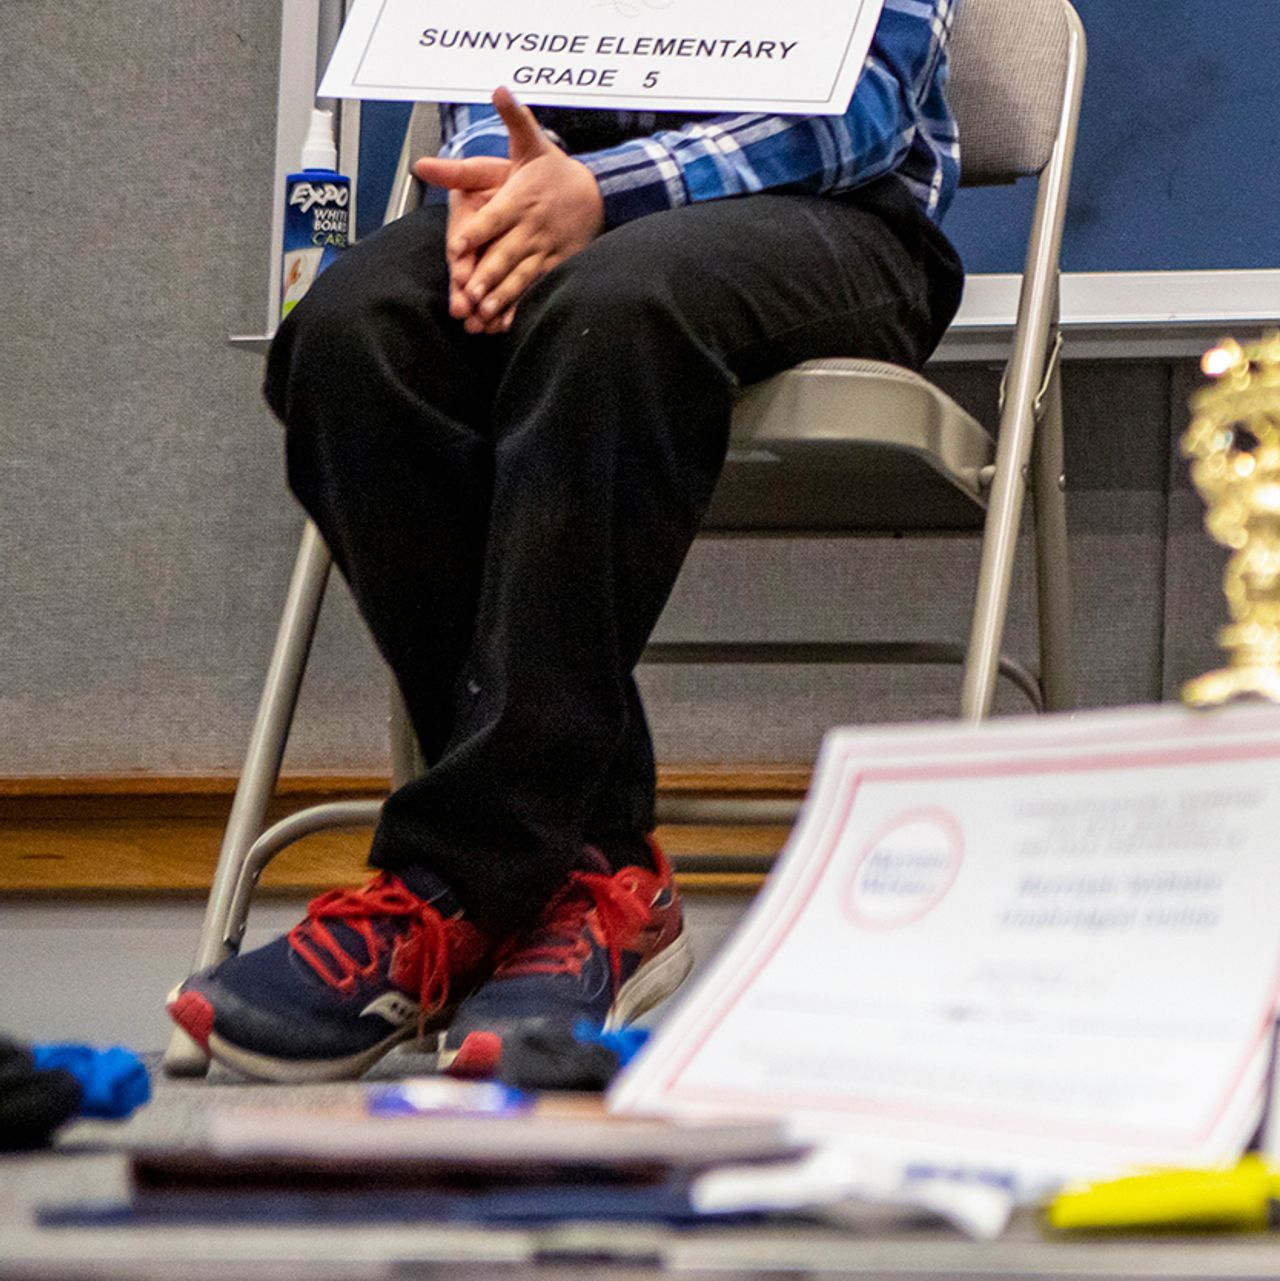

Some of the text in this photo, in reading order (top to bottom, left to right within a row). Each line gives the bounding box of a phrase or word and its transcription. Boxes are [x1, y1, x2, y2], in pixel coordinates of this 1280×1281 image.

[418, 28, 799, 61] SUNNYSIDE ELEMENTARY
[512, 66, 660, 89] GRADE 5
[289, 182, 349, 213] EXPO
